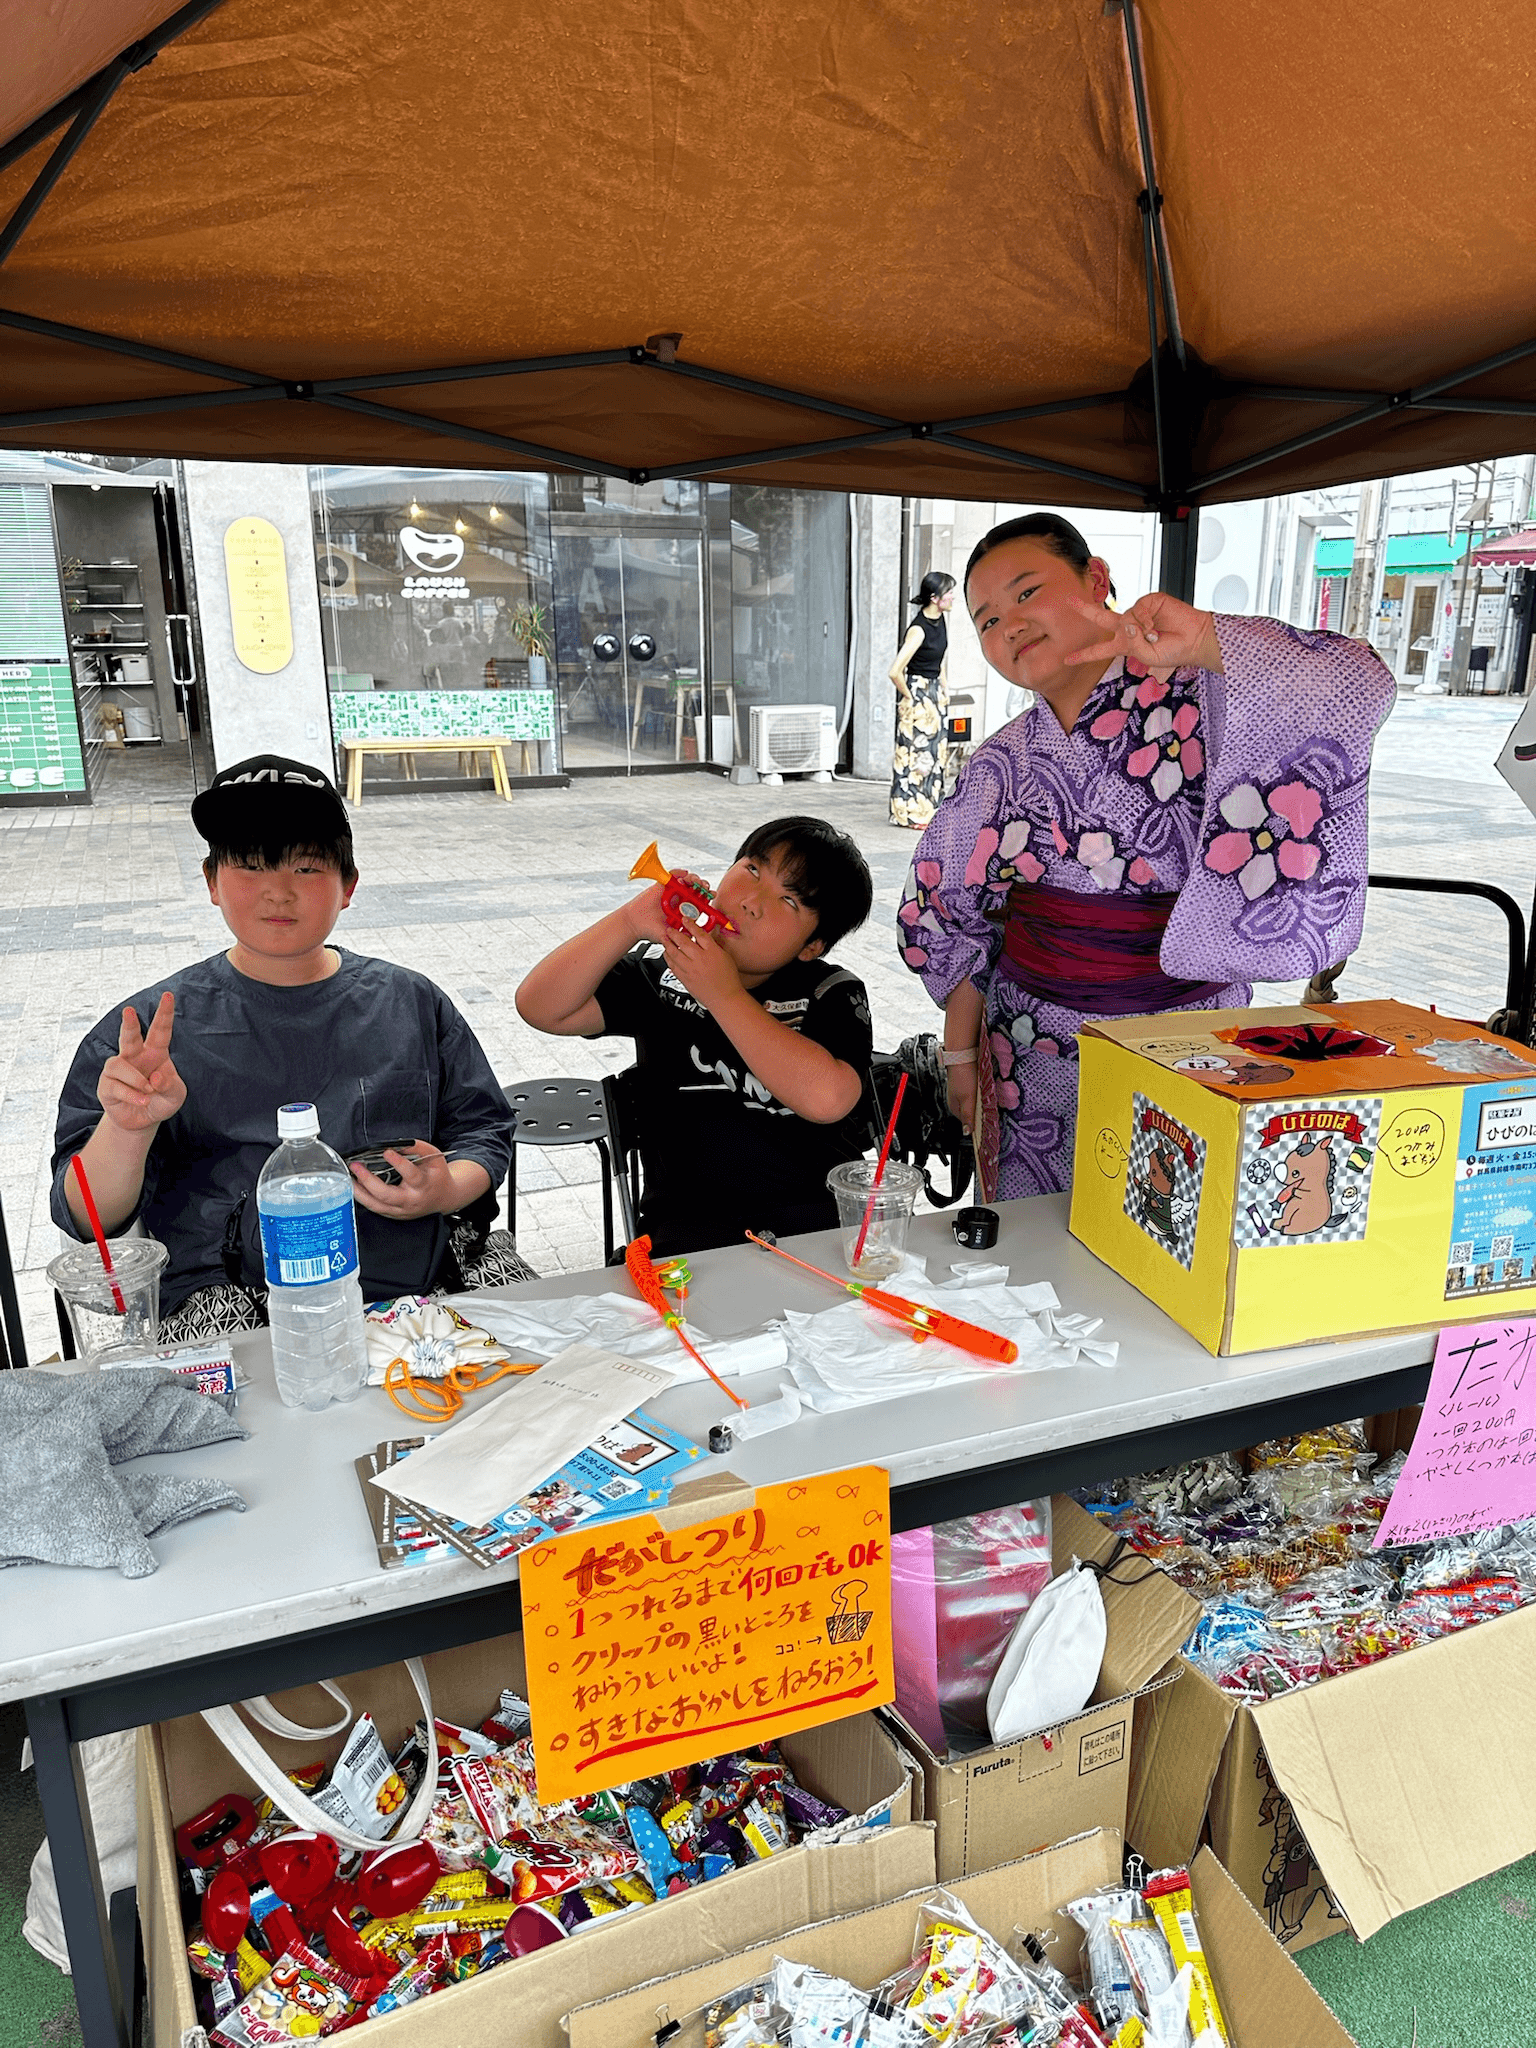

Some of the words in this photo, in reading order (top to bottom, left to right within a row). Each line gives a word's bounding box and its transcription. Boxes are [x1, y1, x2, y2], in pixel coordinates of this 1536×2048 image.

[404, 576, 466, 588] LAUGH
[400, 588, 470, 599] COFFEE
[1151, 1110, 1190, 1149] ひびのば
[1281, 1113, 1351, 1131] ひびのば
[563, 1508, 766, 1597] だがしつり
[571, 1600, 816, 1677] クリップの黒いところを
[973, 1757, 1012, 1778] Furuta
